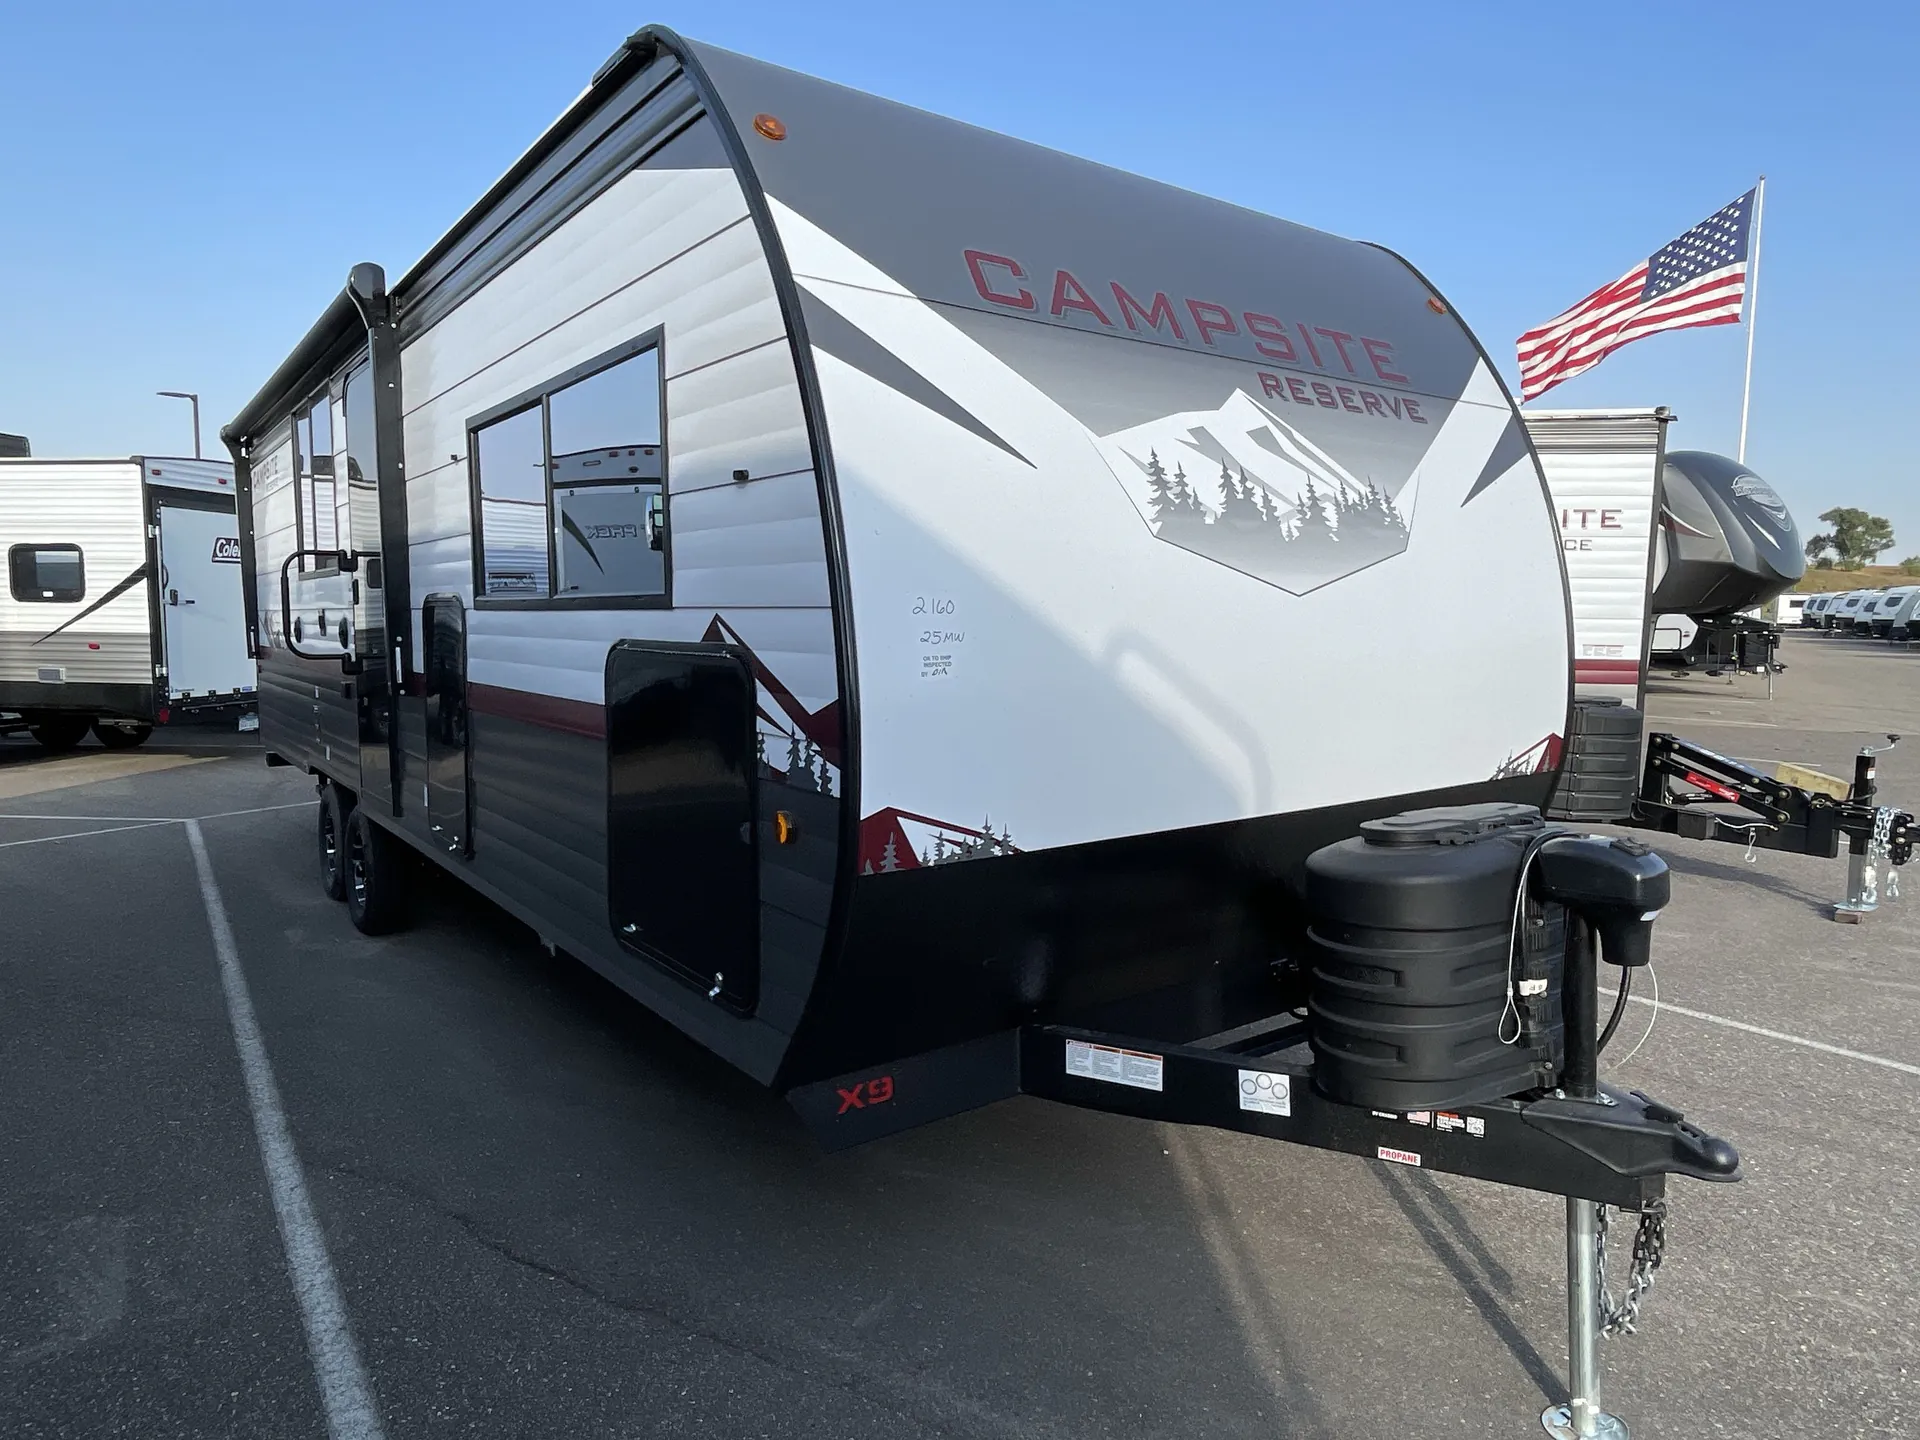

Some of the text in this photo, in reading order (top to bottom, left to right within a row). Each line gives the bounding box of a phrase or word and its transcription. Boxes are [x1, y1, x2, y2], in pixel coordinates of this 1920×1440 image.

[964, 249, 1411, 384] CAMPSITE
[1257, 371, 1428, 424] RESERVE
[215, 539, 240, 557] Cole
[912, 596, 955, 614] 2160
[837, 1076, 894, 1115] X9
[1379, 1149, 1418, 1164] PROPANE
